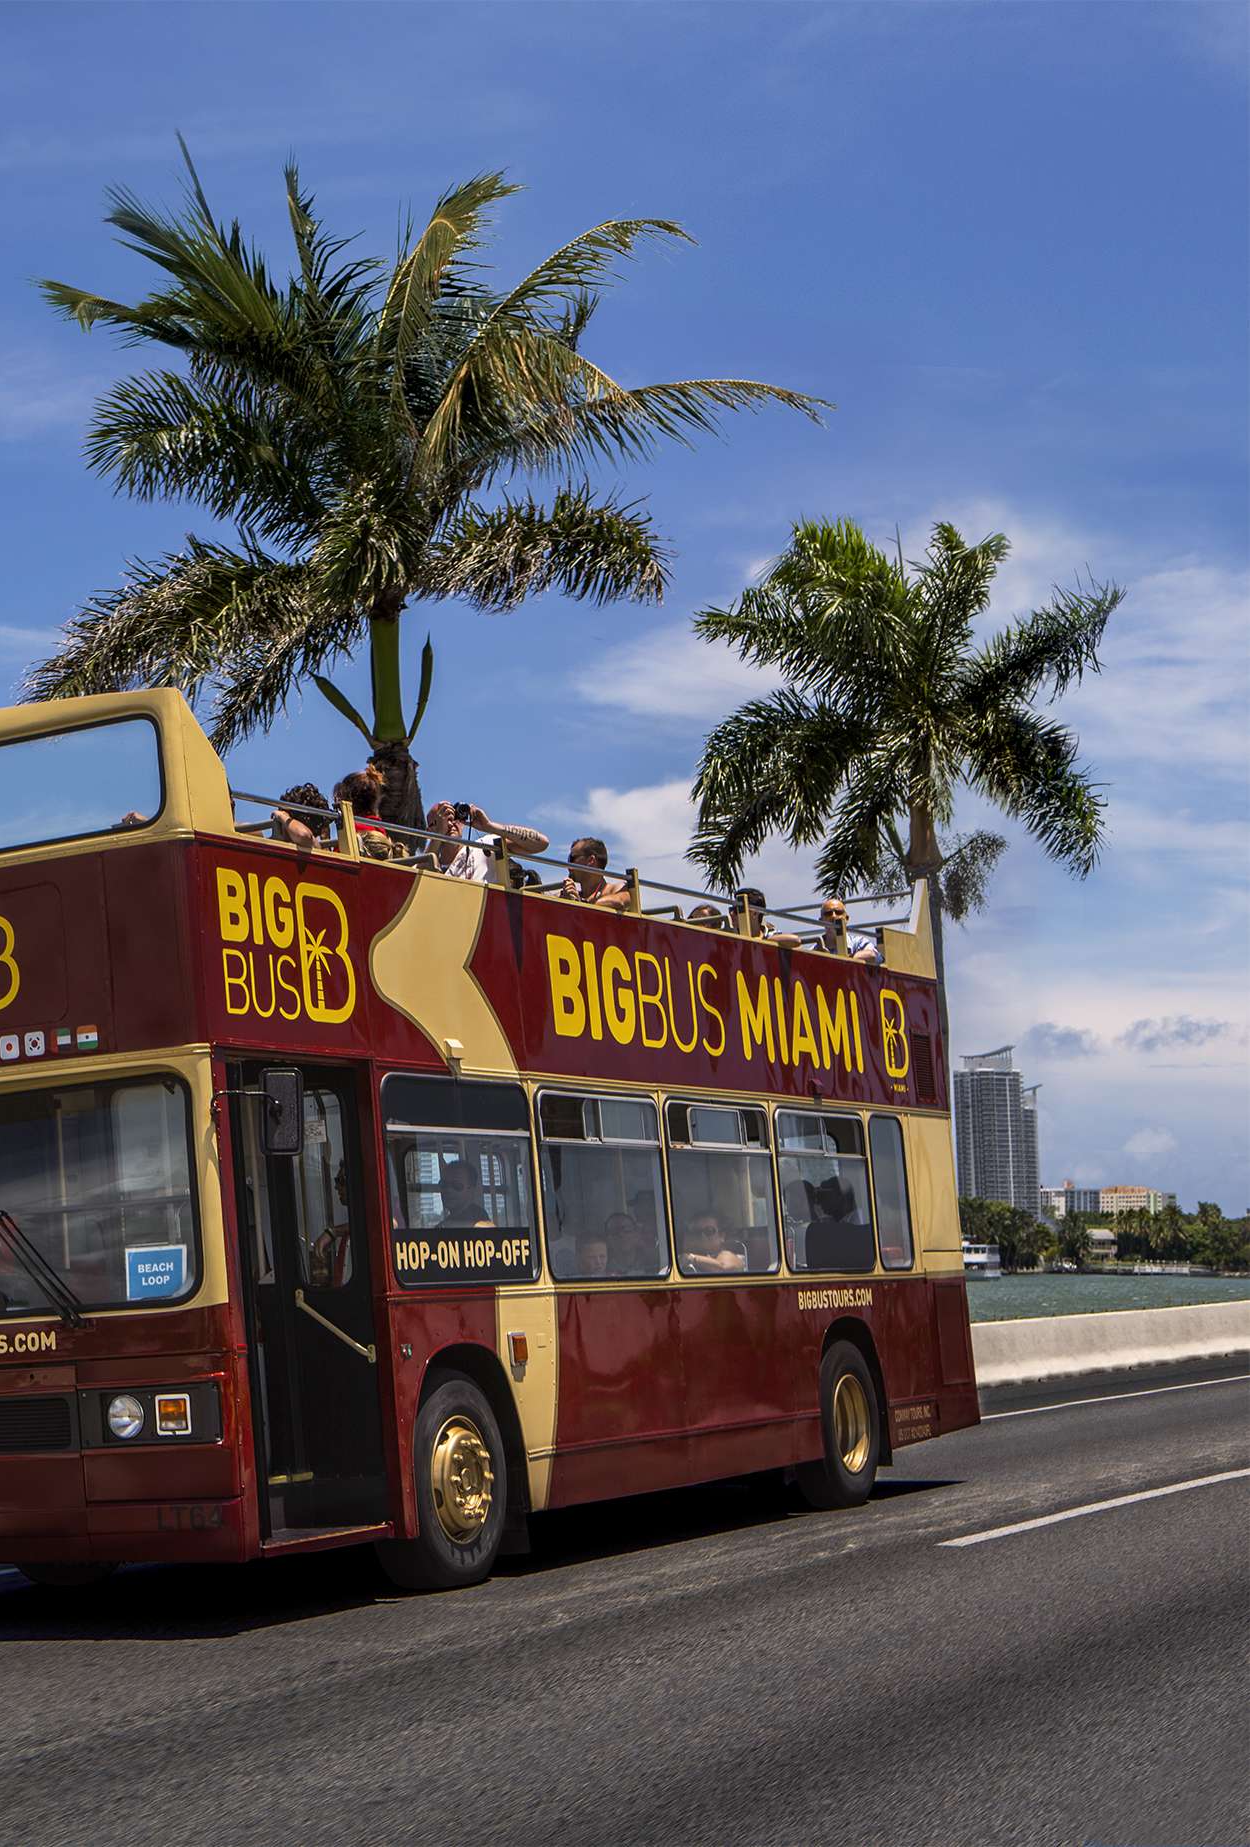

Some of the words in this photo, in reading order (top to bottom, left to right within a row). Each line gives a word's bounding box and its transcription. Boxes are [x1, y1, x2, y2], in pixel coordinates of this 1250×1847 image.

[215, 866, 295, 949] BIG
[221, 947, 302, 1021] BUS
[735, 969, 864, 1074] MIAMI
[137, 1261, 175, 1274] BEACH
[395, 1240, 461, 1271] HOP-ON
[463, 1239, 530, 1268] HOP-OFF
[141, 1275, 171, 1287] LOOP
[797, 1288, 873, 1311] BIGBUSTOURS.COM
